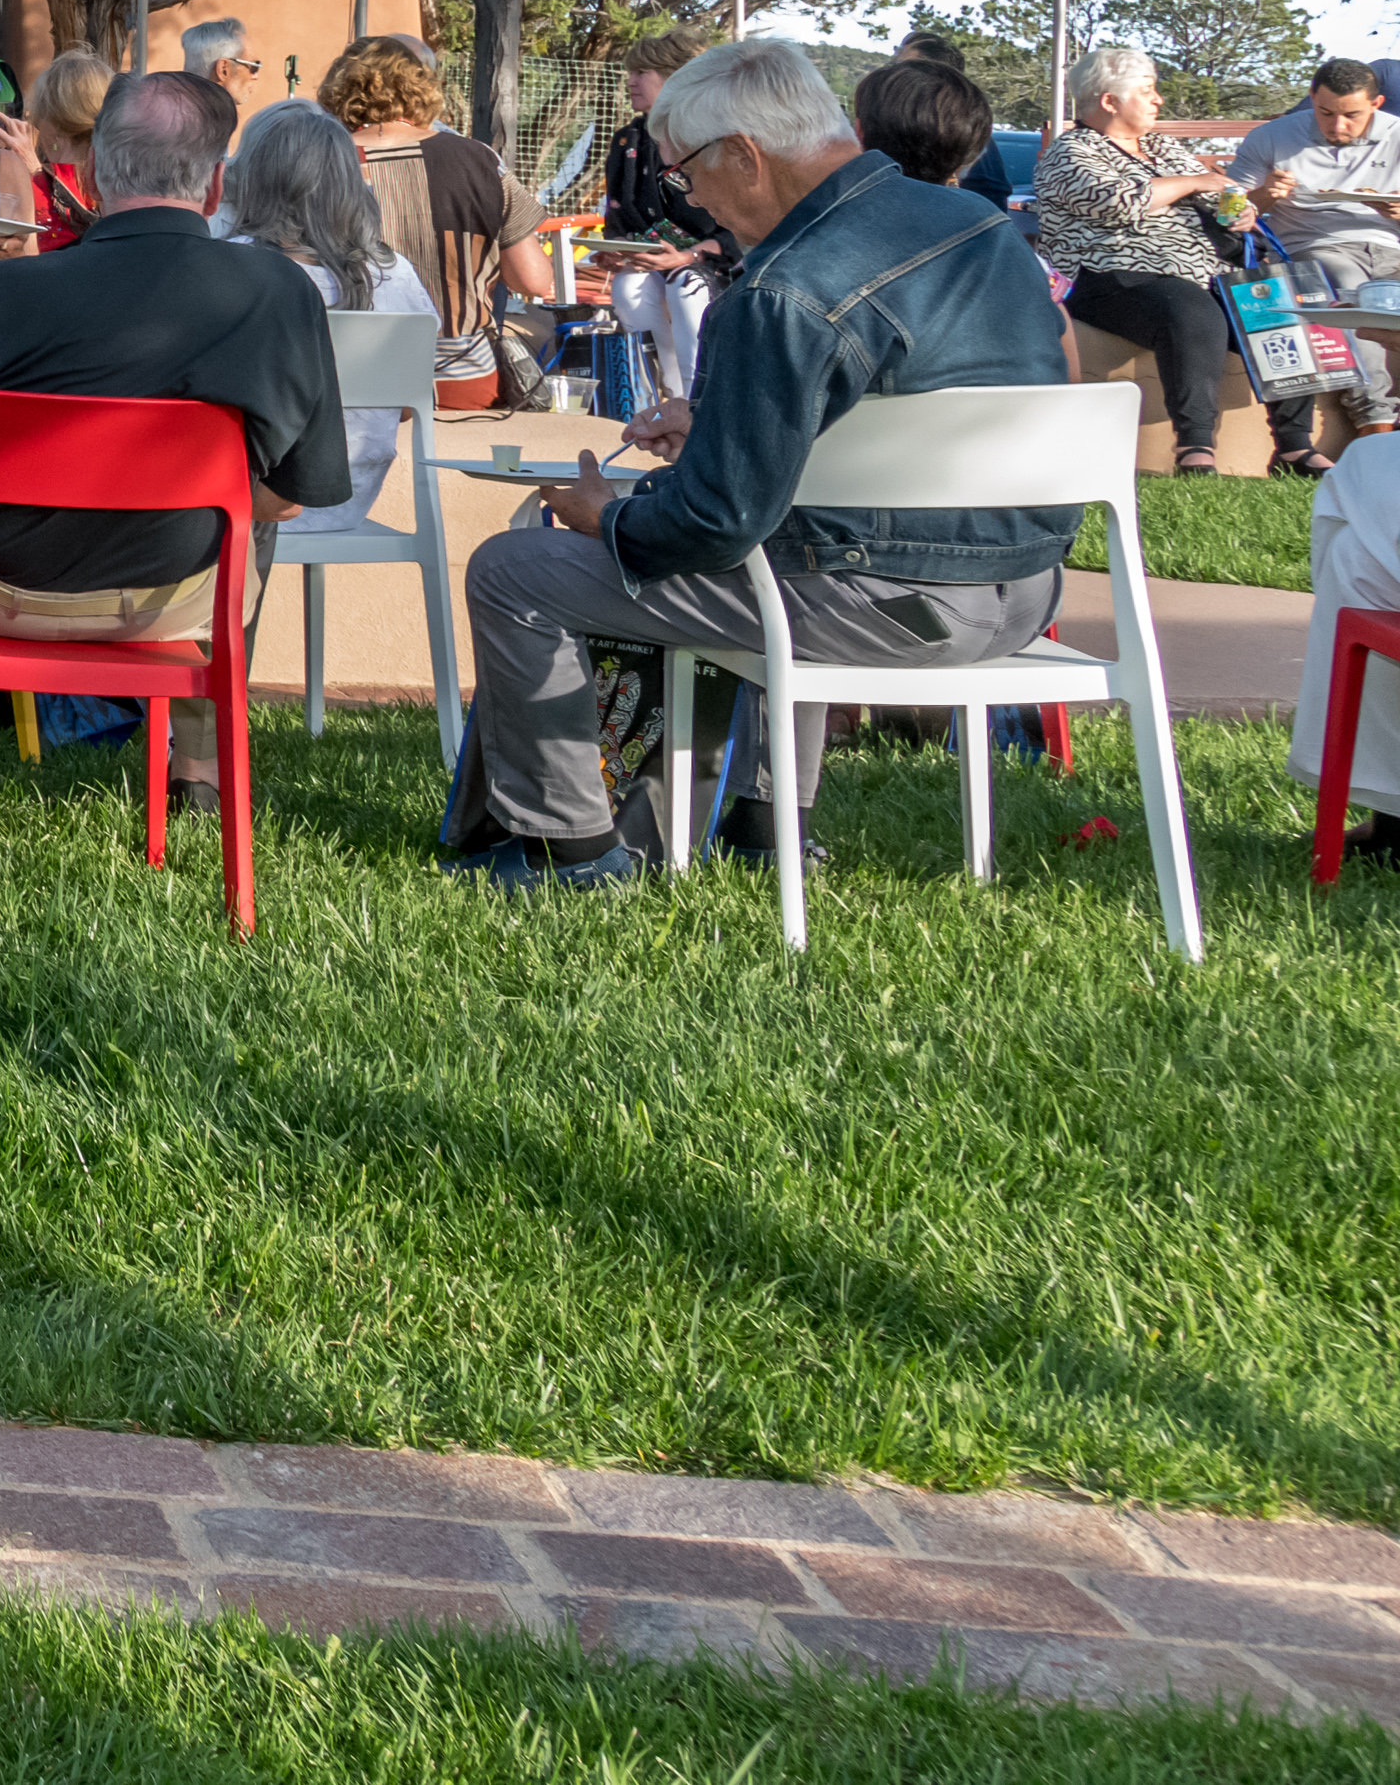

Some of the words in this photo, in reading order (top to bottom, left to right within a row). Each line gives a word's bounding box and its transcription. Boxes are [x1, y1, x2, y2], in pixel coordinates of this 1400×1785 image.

[597, 640, 615, 649] ART
[618, 642, 656, 654] MARKET
[703, 666, 718, 677] FE
